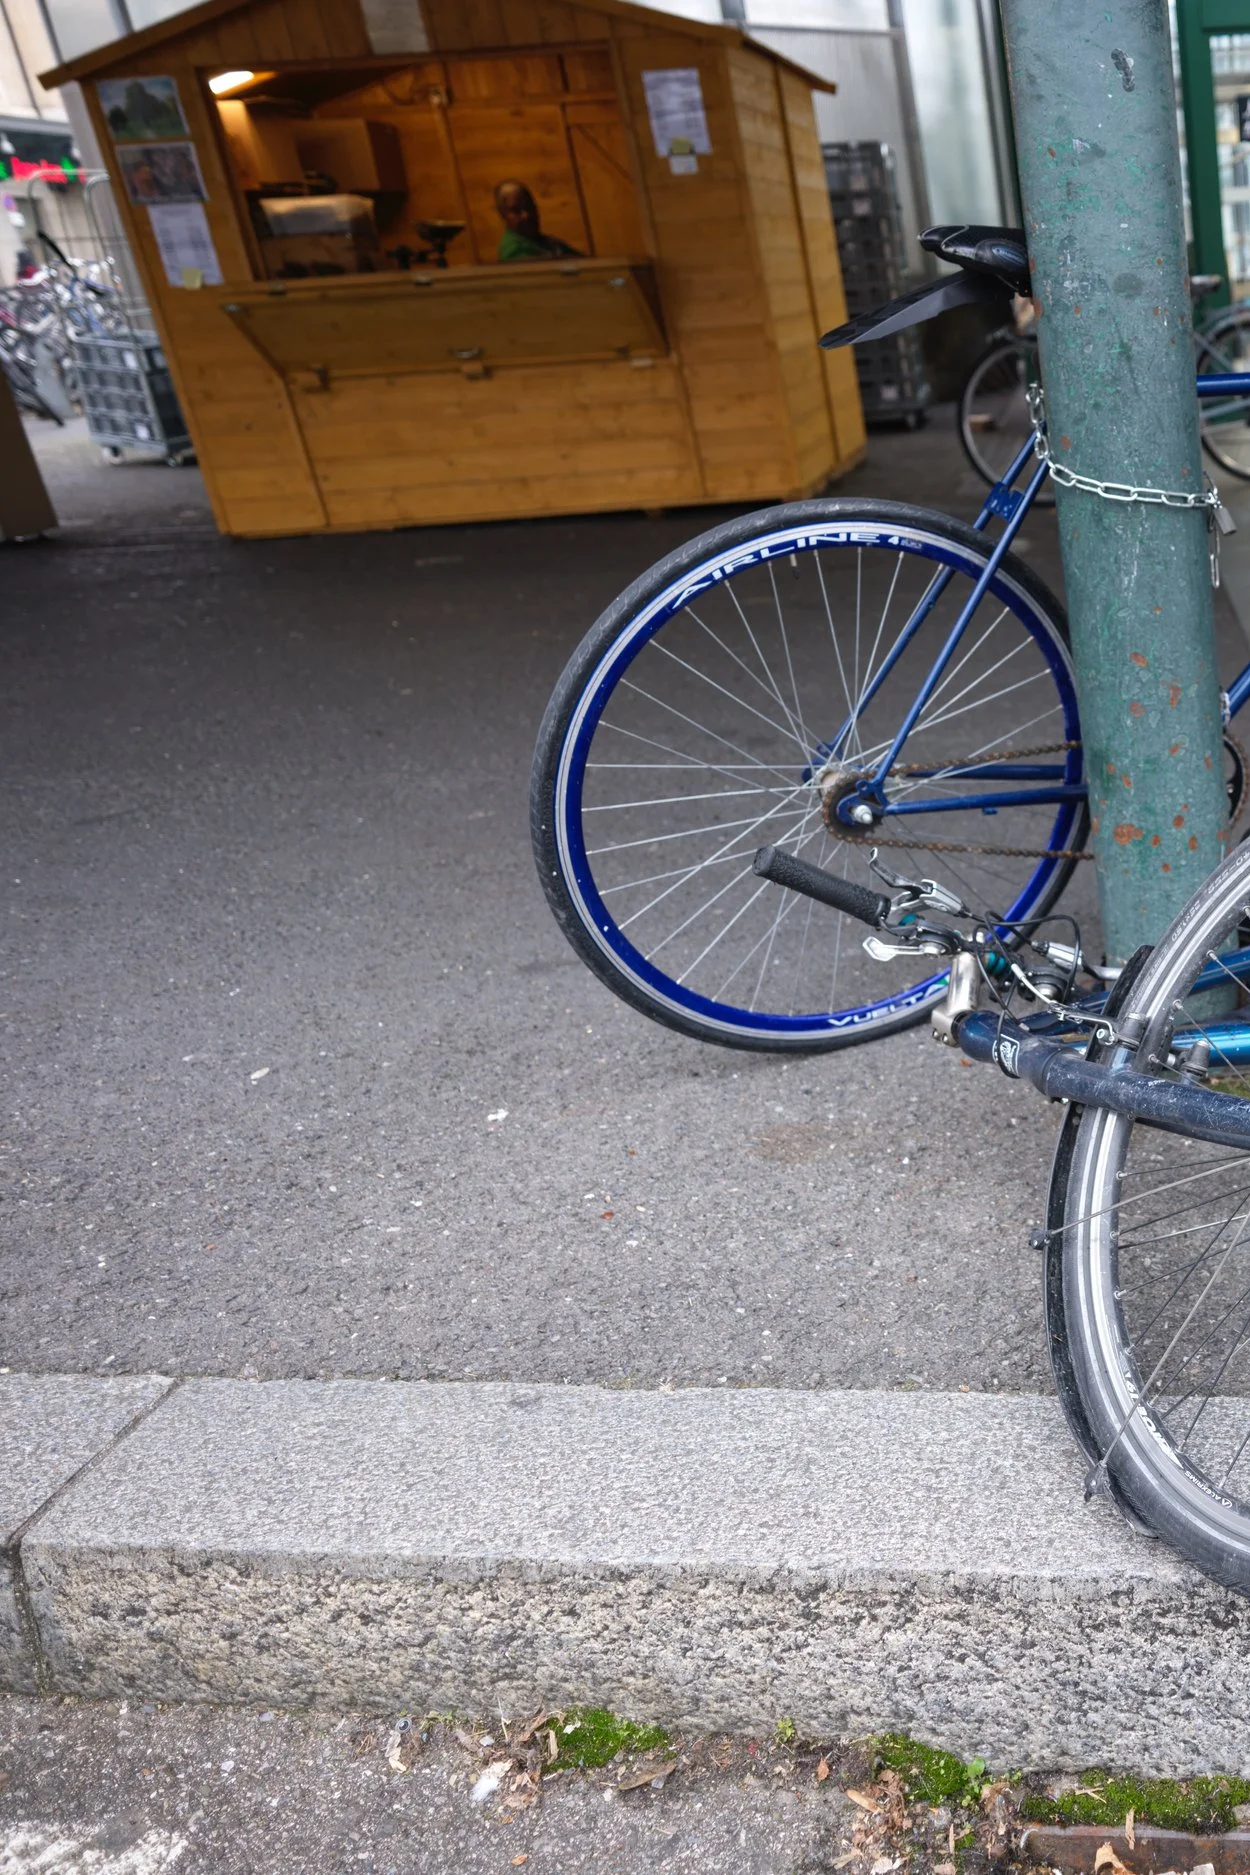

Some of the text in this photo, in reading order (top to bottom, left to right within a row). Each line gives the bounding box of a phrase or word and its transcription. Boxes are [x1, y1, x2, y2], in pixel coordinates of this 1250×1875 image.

[672, 532, 880, 609] AIRLINE
[828, 983, 947, 1027] VUELTA
[1184, 1470, 1222, 1502] ALEXRIMS
